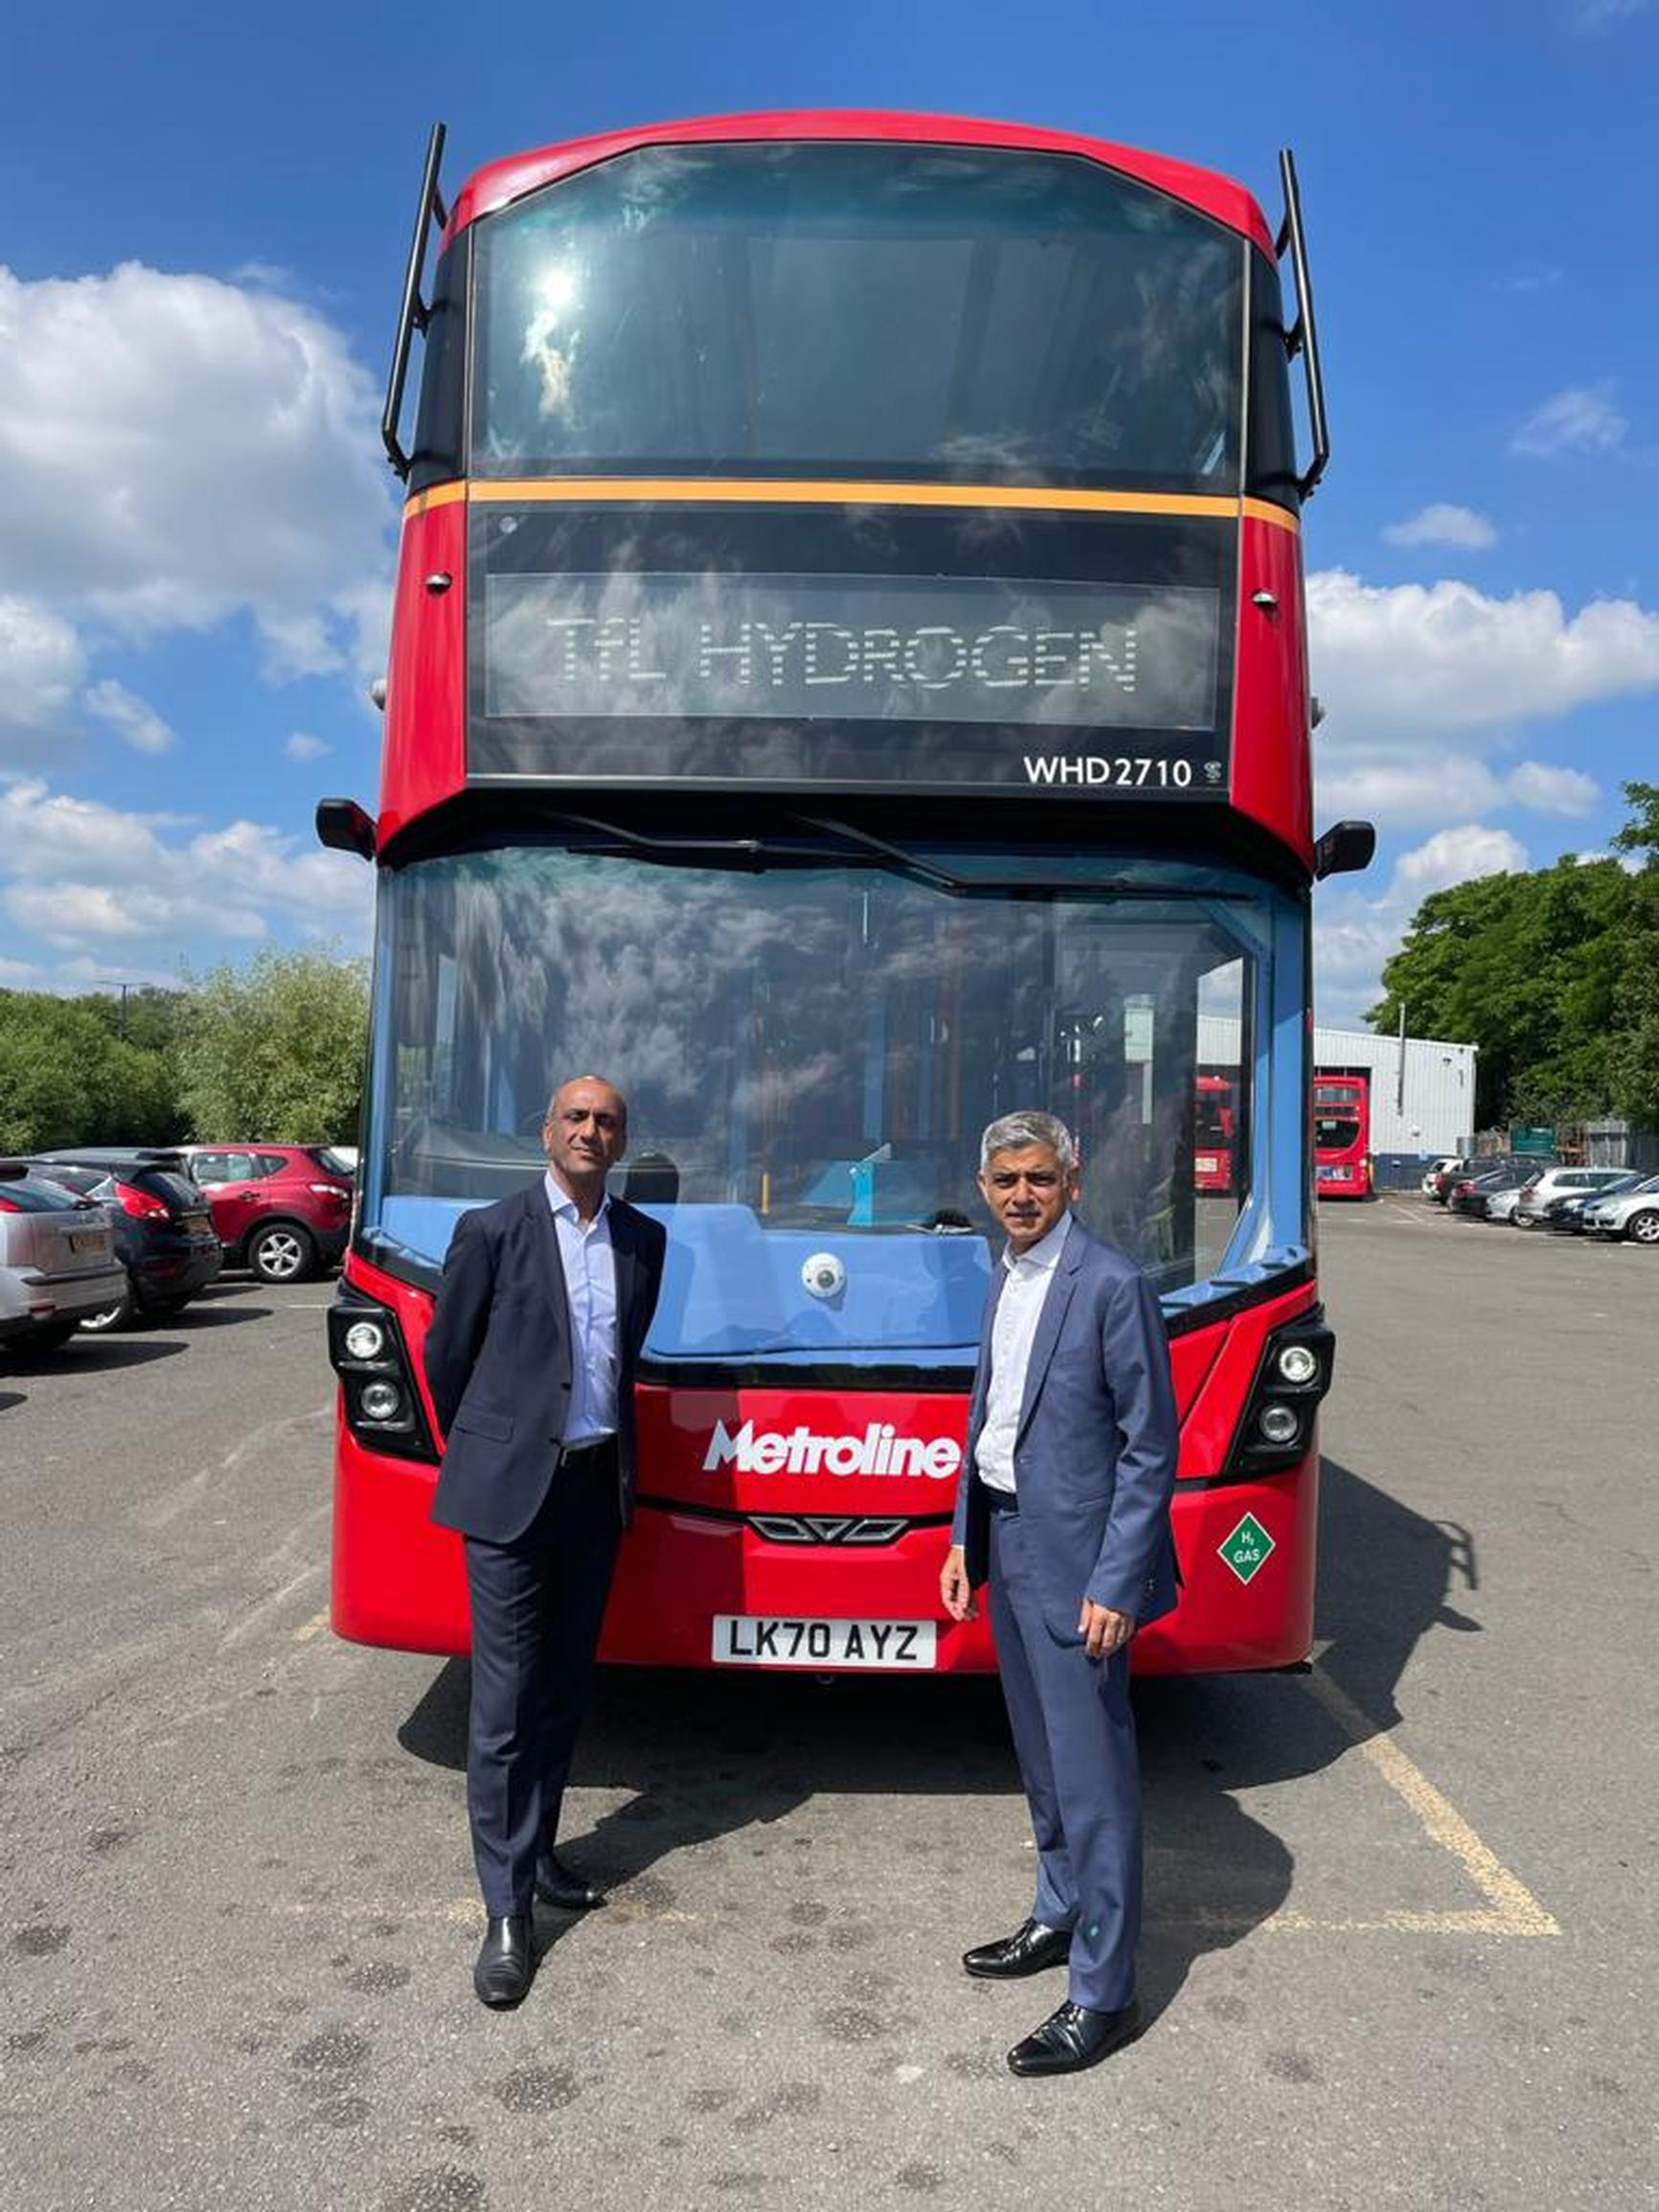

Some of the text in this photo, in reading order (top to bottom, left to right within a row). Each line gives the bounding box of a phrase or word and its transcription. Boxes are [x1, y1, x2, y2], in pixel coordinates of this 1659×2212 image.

[700, 623, 1136, 692] HYDROGEN
[1023, 756, 1193, 787] WHD2710
[702, 1418, 962, 1480] Metroline
[1234, 1548, 1261, 1563] GAS
[729, 1620, 919, 1660] LK70 AYZ
